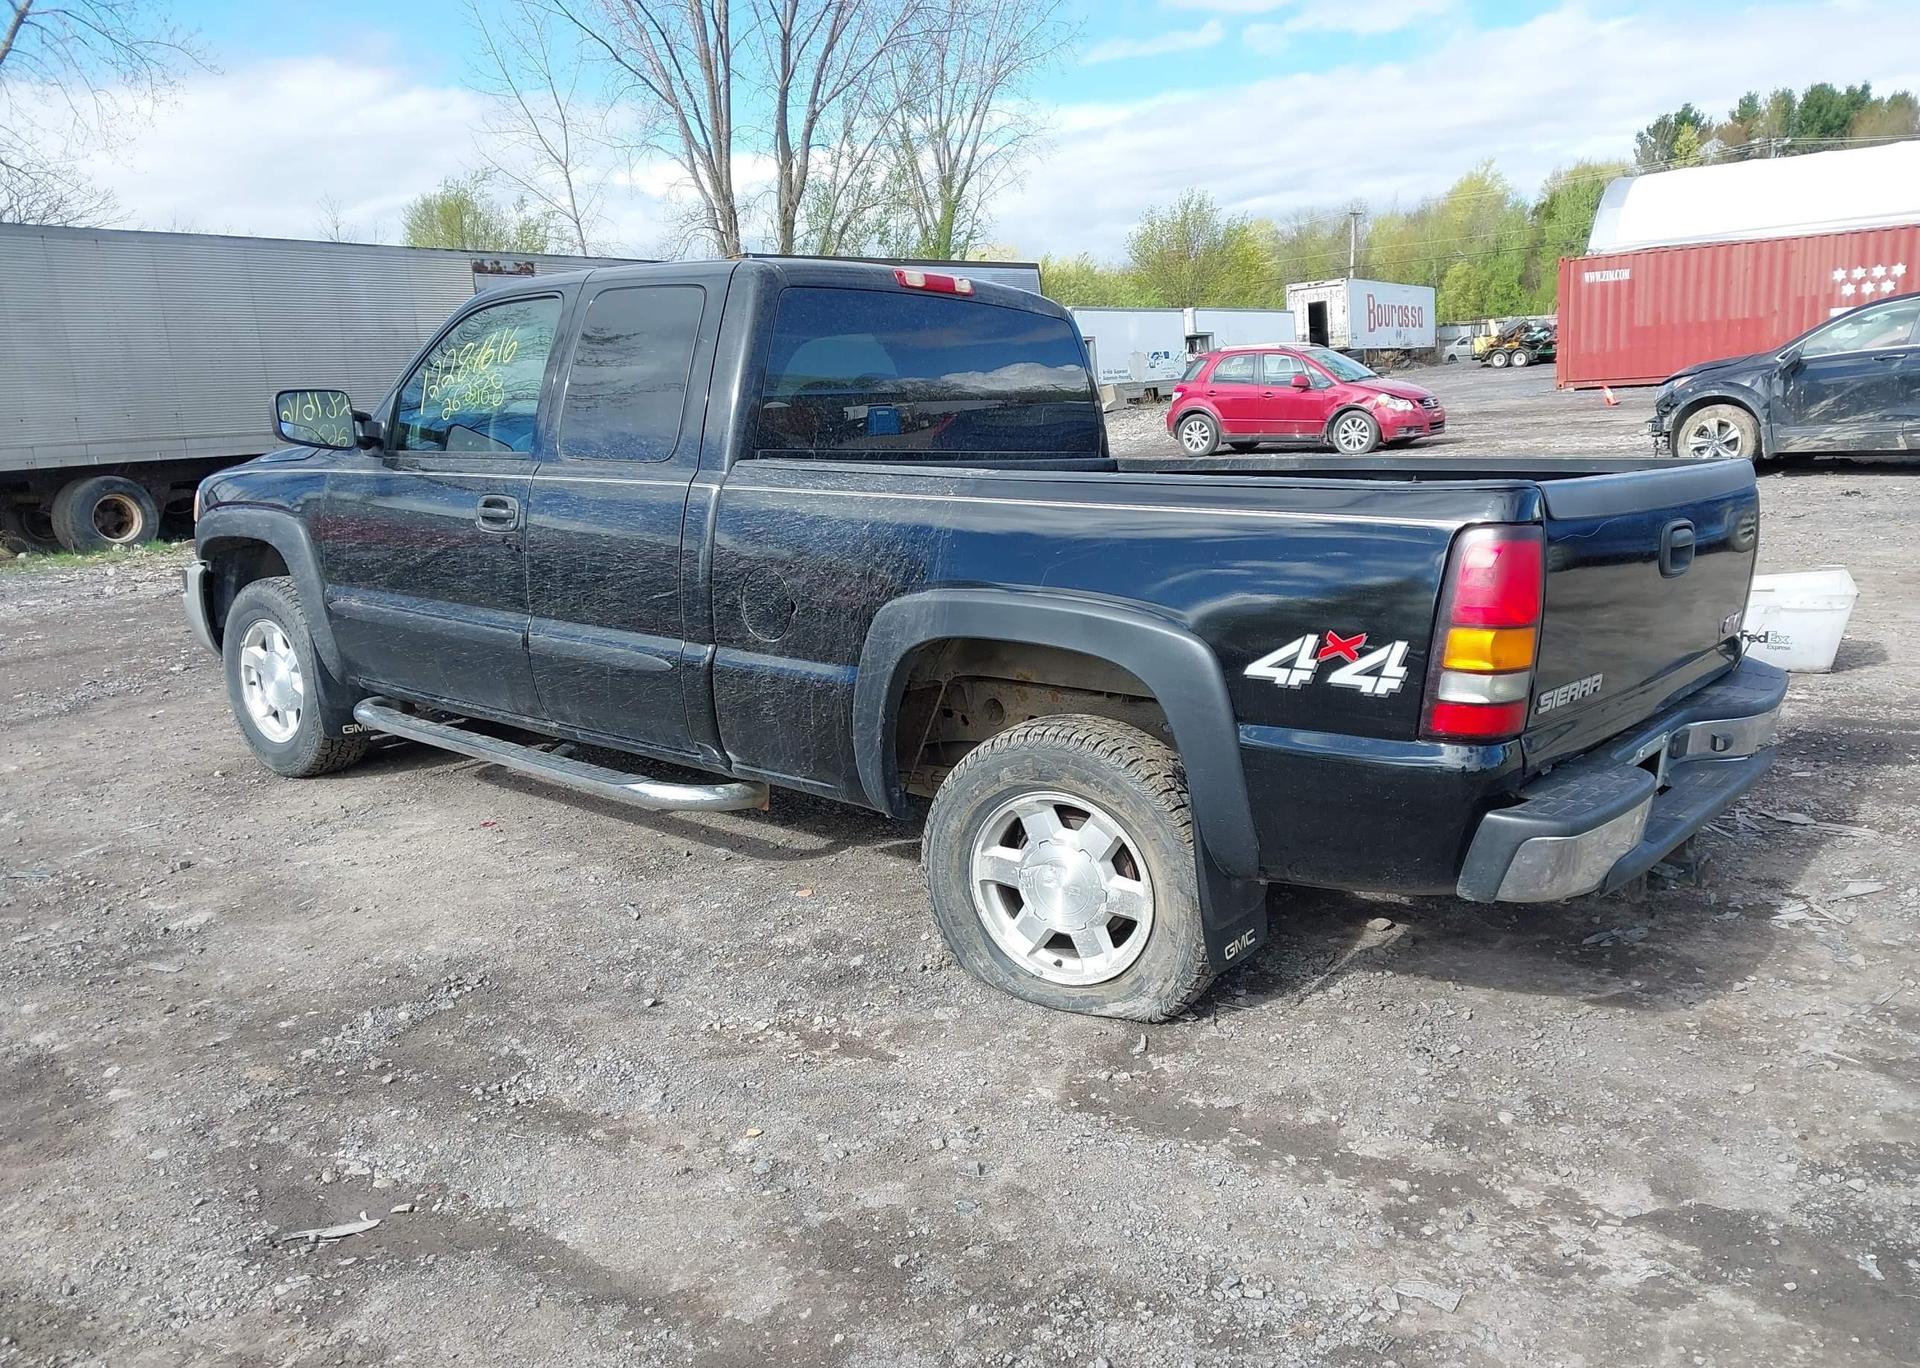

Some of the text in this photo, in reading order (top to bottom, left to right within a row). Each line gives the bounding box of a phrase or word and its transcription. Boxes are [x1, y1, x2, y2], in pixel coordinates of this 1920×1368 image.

[1584, 268, 1631, 283] WWW.ZIM.COM
[1367, 293, 1424, 333] Bourassa
[1740, 629, 1793, 645] FedEx
[1766, 643, 1791, 651] Express
[1536, 672, 1604, 714] SIERRA
[1224, 928, 1256, 960] GMC
